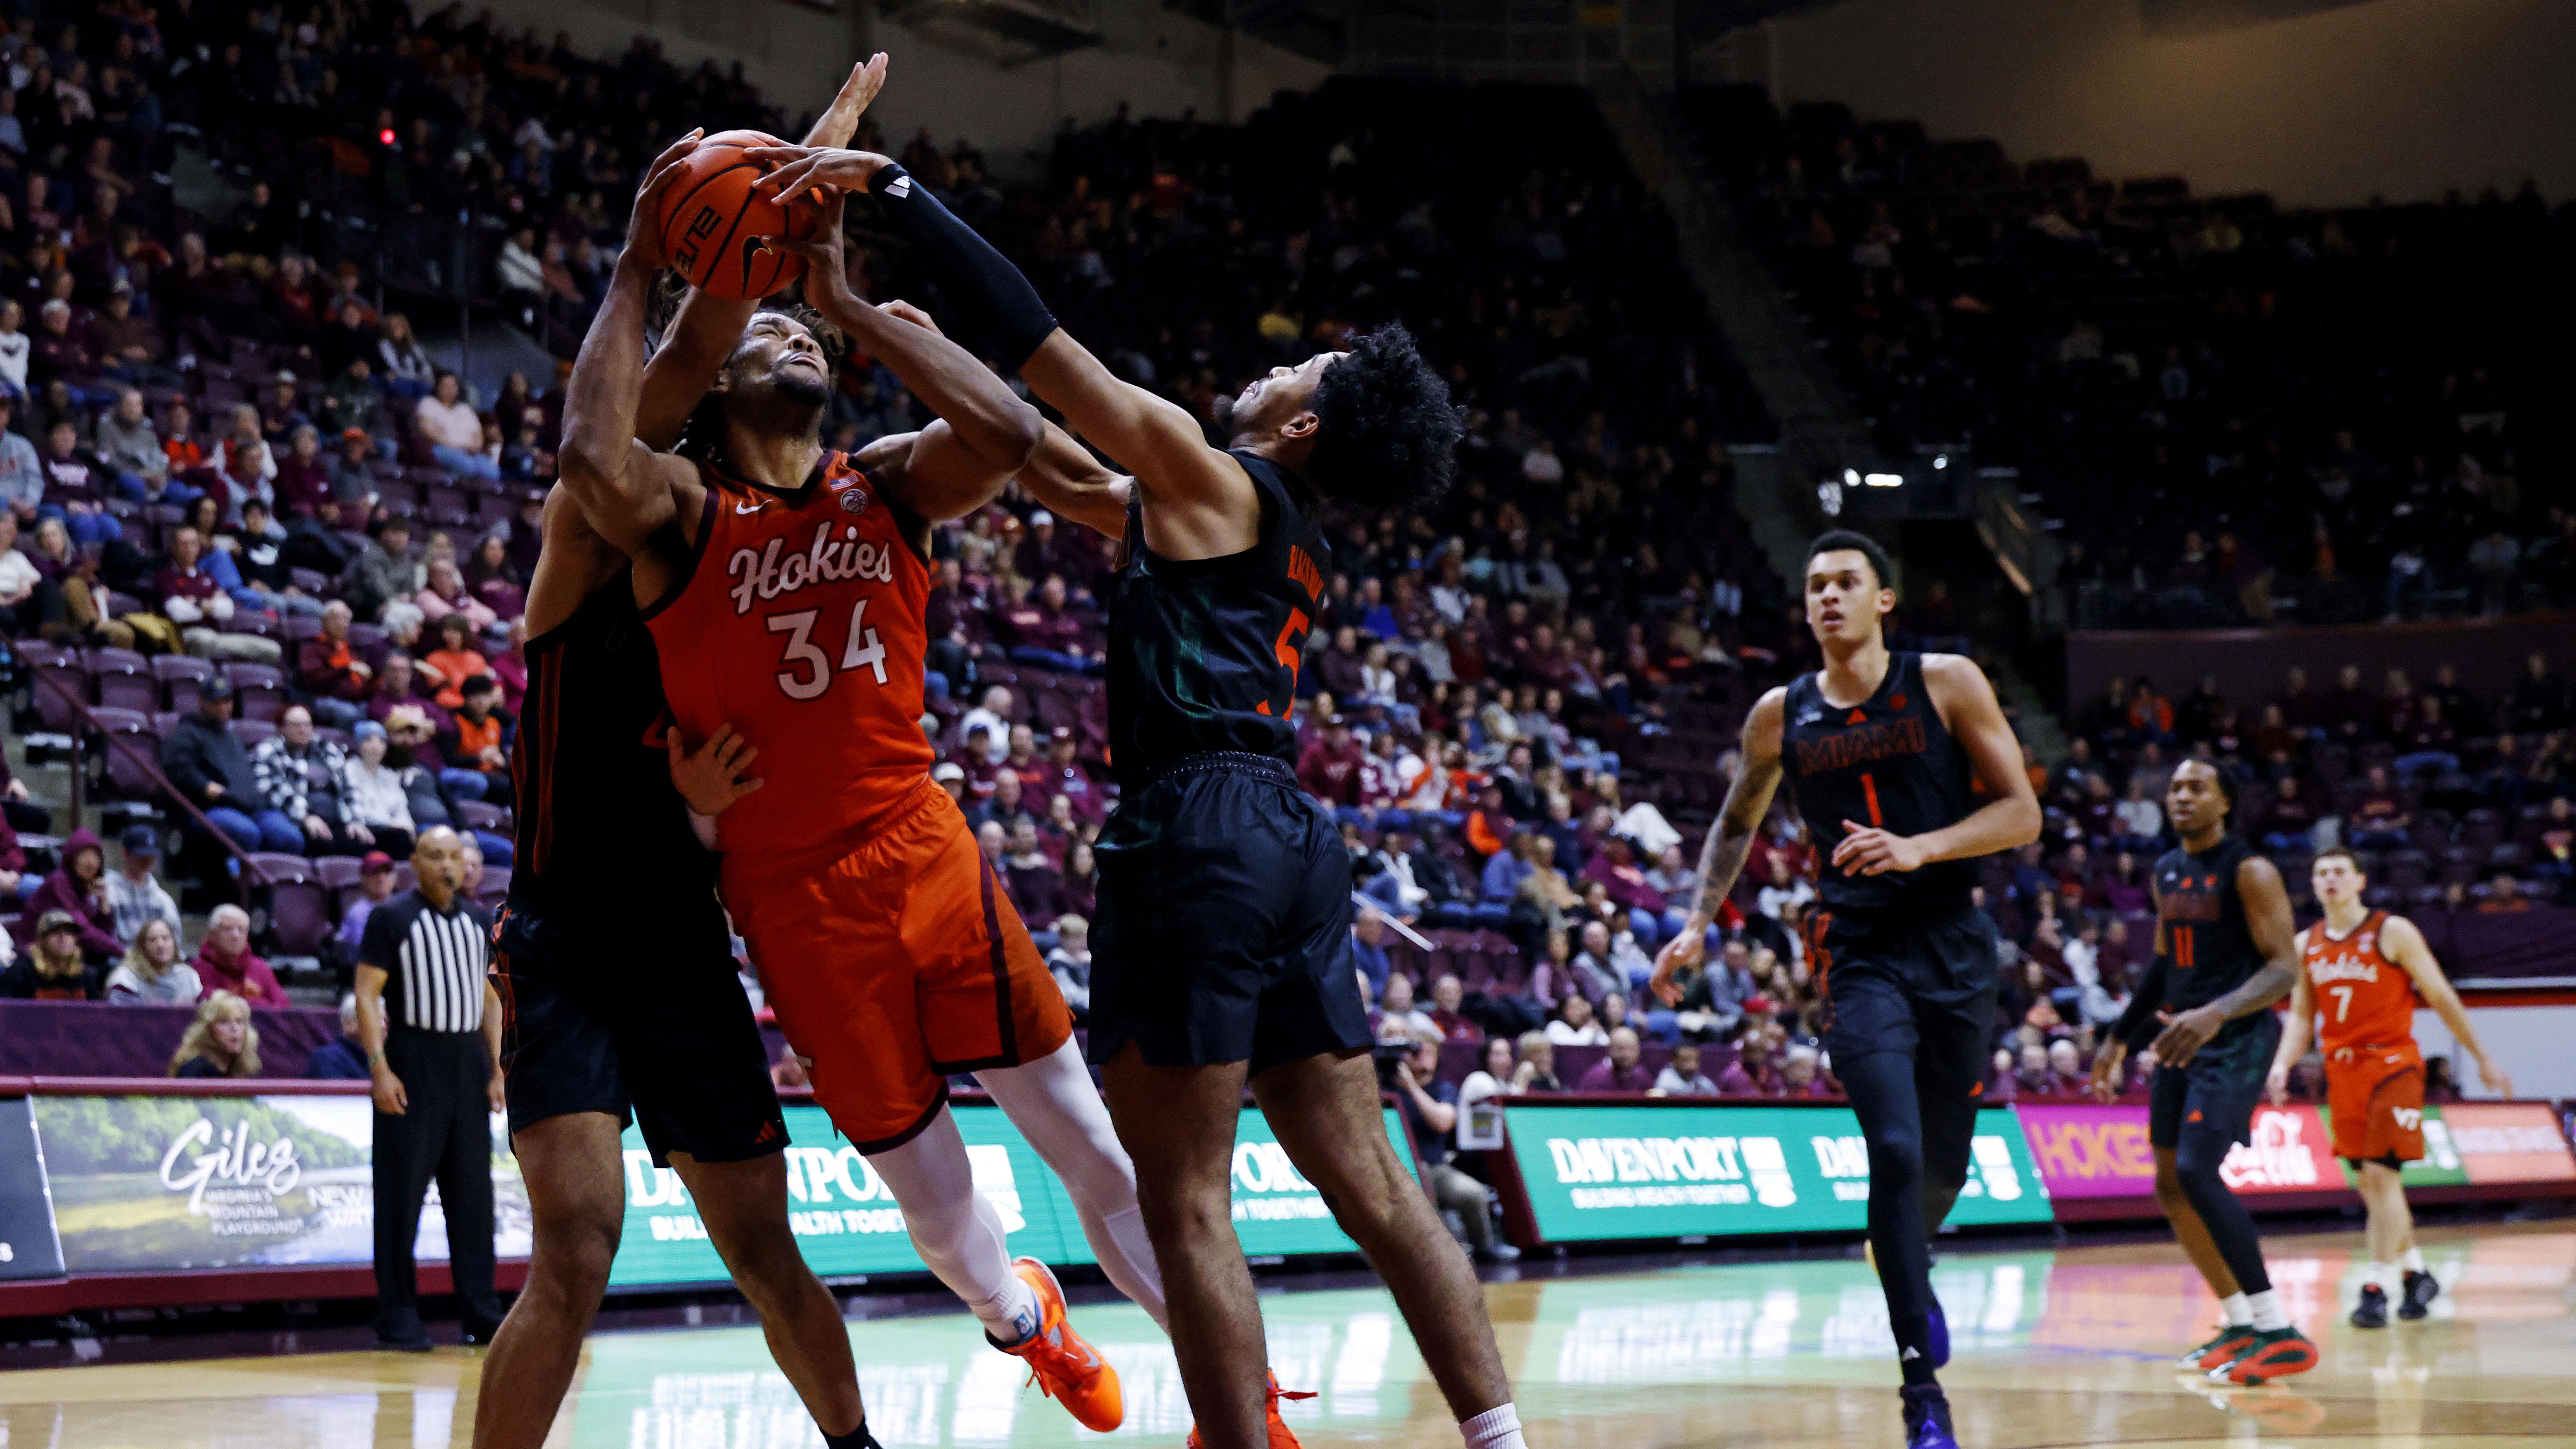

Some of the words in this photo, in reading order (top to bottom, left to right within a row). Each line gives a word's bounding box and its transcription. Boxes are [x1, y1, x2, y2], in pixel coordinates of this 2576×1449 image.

[674, 204, 722, 276] ELITE
[729, 521, 892, 615] Hokies
[767, 599, 887, 699] 34
[1256, 605, 1309, 721] 5
[1795, 716, 1927, 776] MIAMI
[1860, 773, 1883, 826] 1
[2174, 926, 2195, 968] 11
[2329, 986, 2353, 1024] 7
[160, 1118, 302, 1216] Giles
[1546, 1136, 1743, 1184] DAVENPORT
[2030, 1121, 2157, 1179] HOKIE
[307, 1185, 365, 1208] NEW
[650, 1216, 709, 1241] BUIL
[842, 1208, 908, 1234] TOGE
